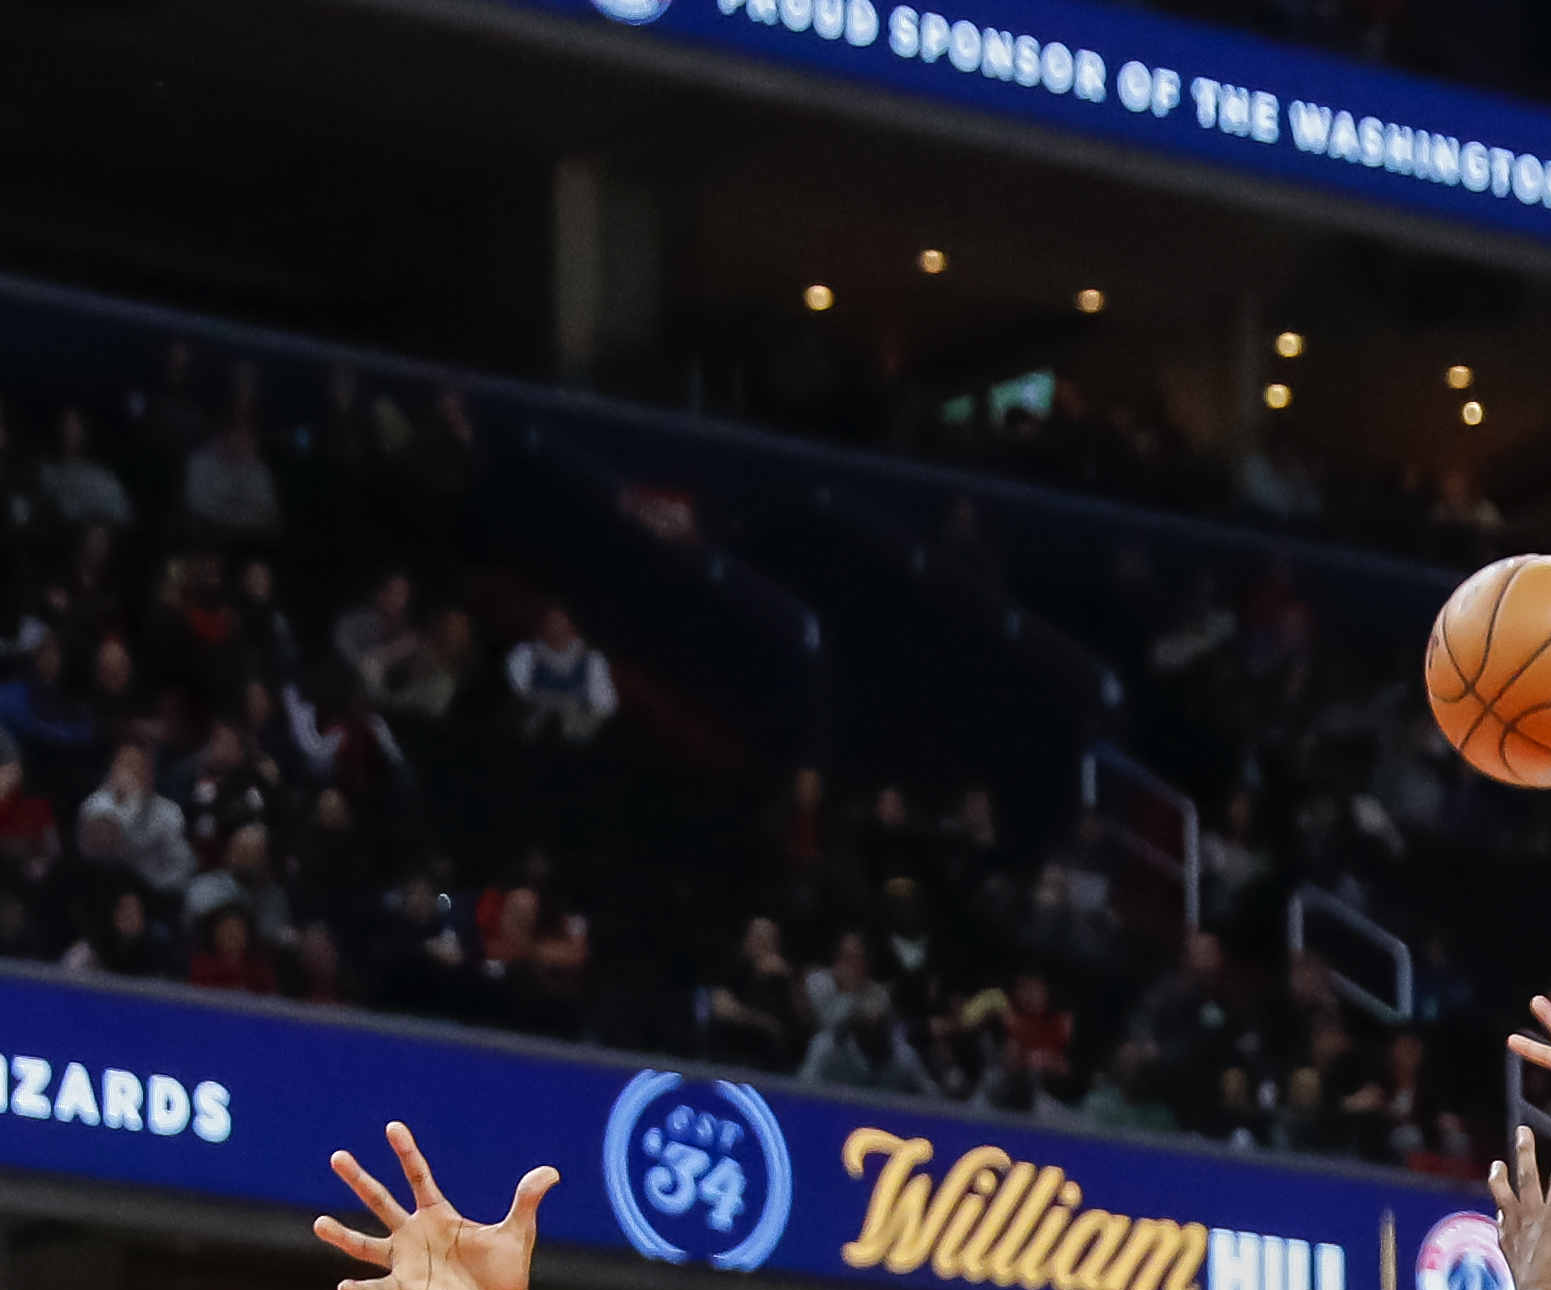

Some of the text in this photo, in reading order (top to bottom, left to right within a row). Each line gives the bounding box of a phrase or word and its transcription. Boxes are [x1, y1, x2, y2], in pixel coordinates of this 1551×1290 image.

[717, 0, 879, 47] OUD
[889, 4, 1106, 103] SPONSOR
[1117, 60, 1181, 118] OF
[1191, 76, 1279, 143] THE
